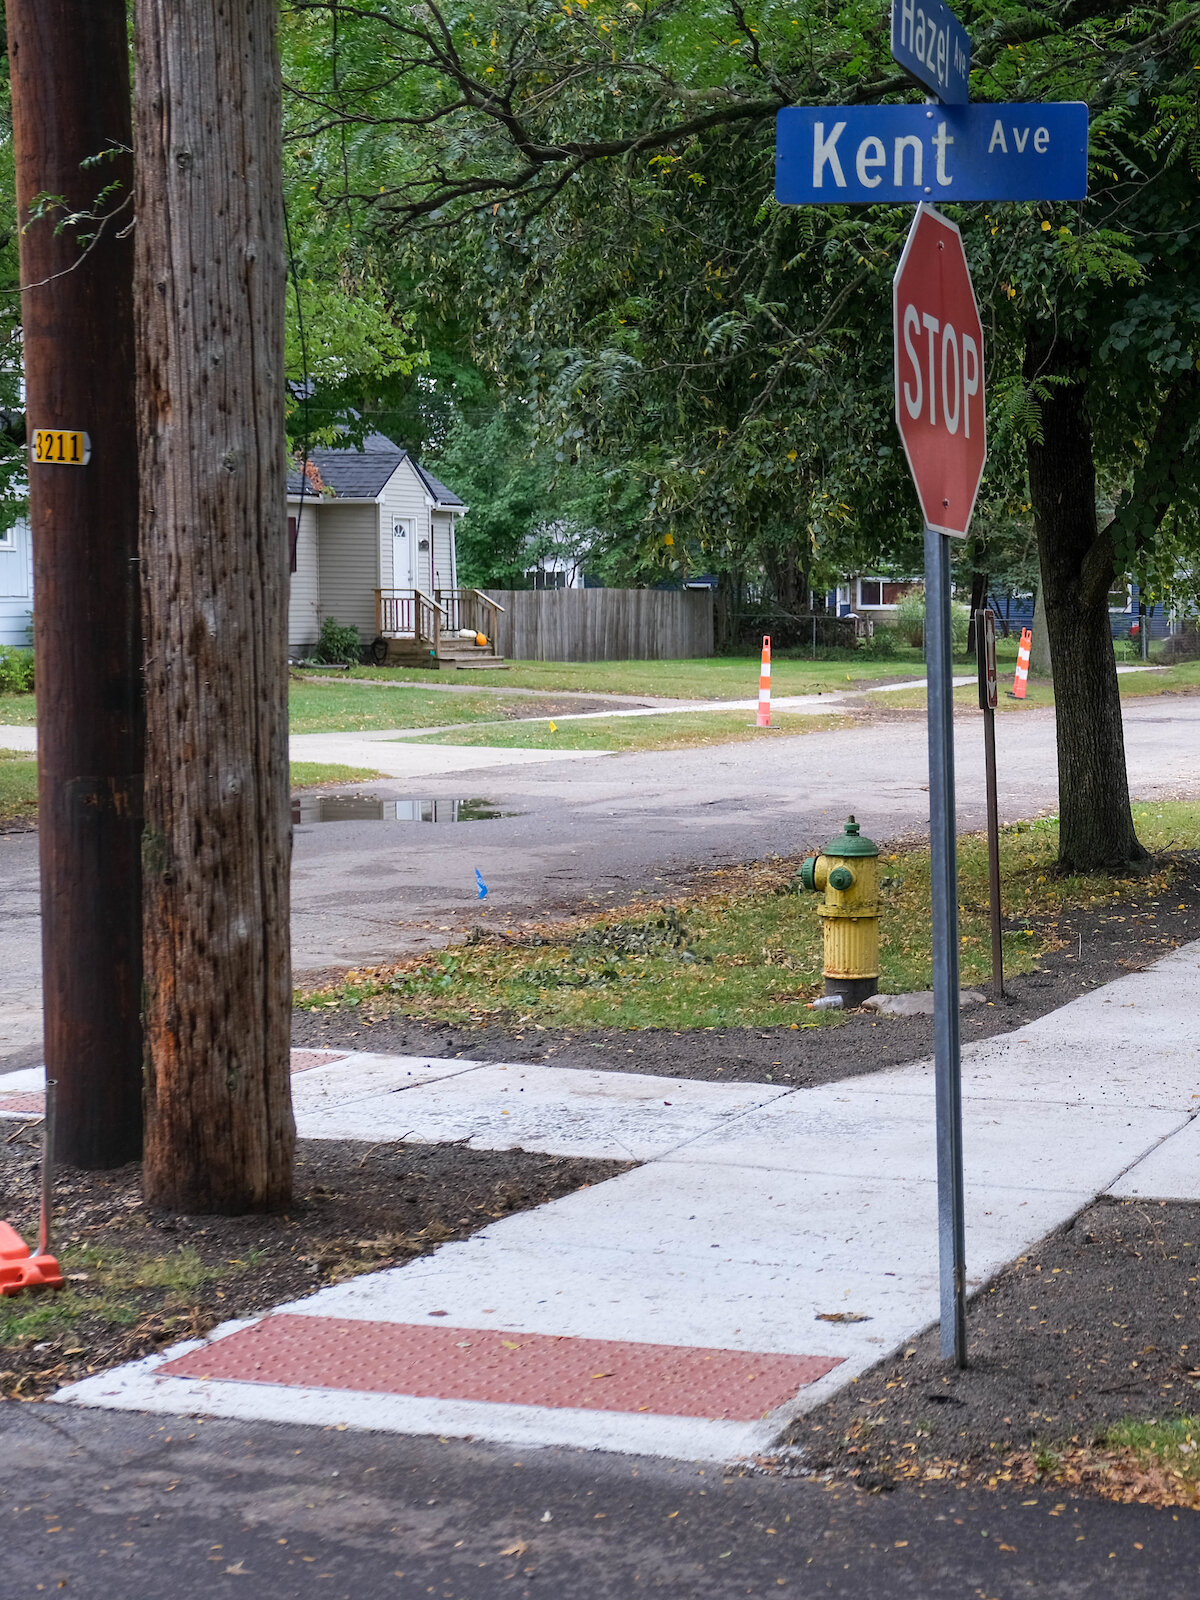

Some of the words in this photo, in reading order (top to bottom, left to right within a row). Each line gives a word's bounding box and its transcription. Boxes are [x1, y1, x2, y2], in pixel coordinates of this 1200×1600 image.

[901, 0, 950, 87] Hazel
[953, 36, 966, 79] Ave
[812, 121, 954, 188] Kent
[988, 120, 1050, 153] Ave
[903, 303, 979, 439] STOP
[36, 432, 80, 461] 3211
